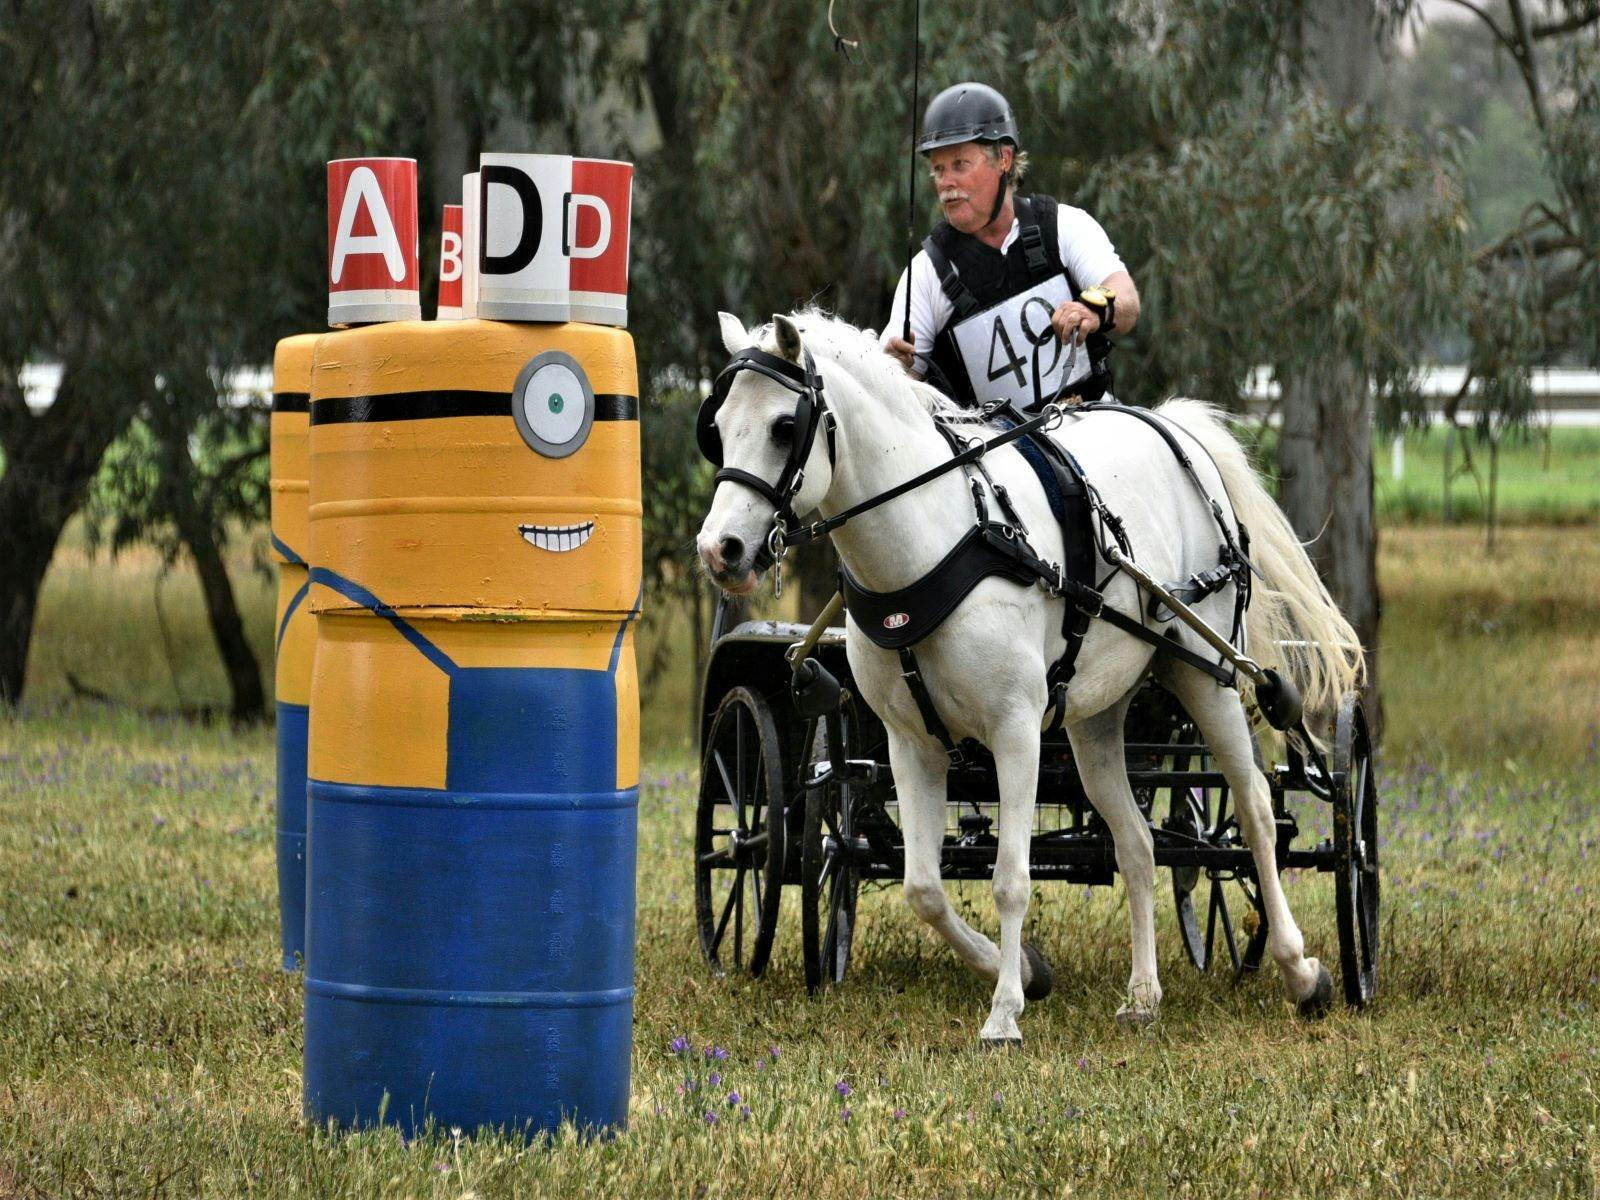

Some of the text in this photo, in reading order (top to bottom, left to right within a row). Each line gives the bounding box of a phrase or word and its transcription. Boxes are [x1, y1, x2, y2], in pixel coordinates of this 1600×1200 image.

[331, 166, 406, 284] A
[439, 231, 463, 282] B
[479, 165, 543, 275] D
[569, 193, 612, 259] D
[987, 296, 1063, 388] 49
